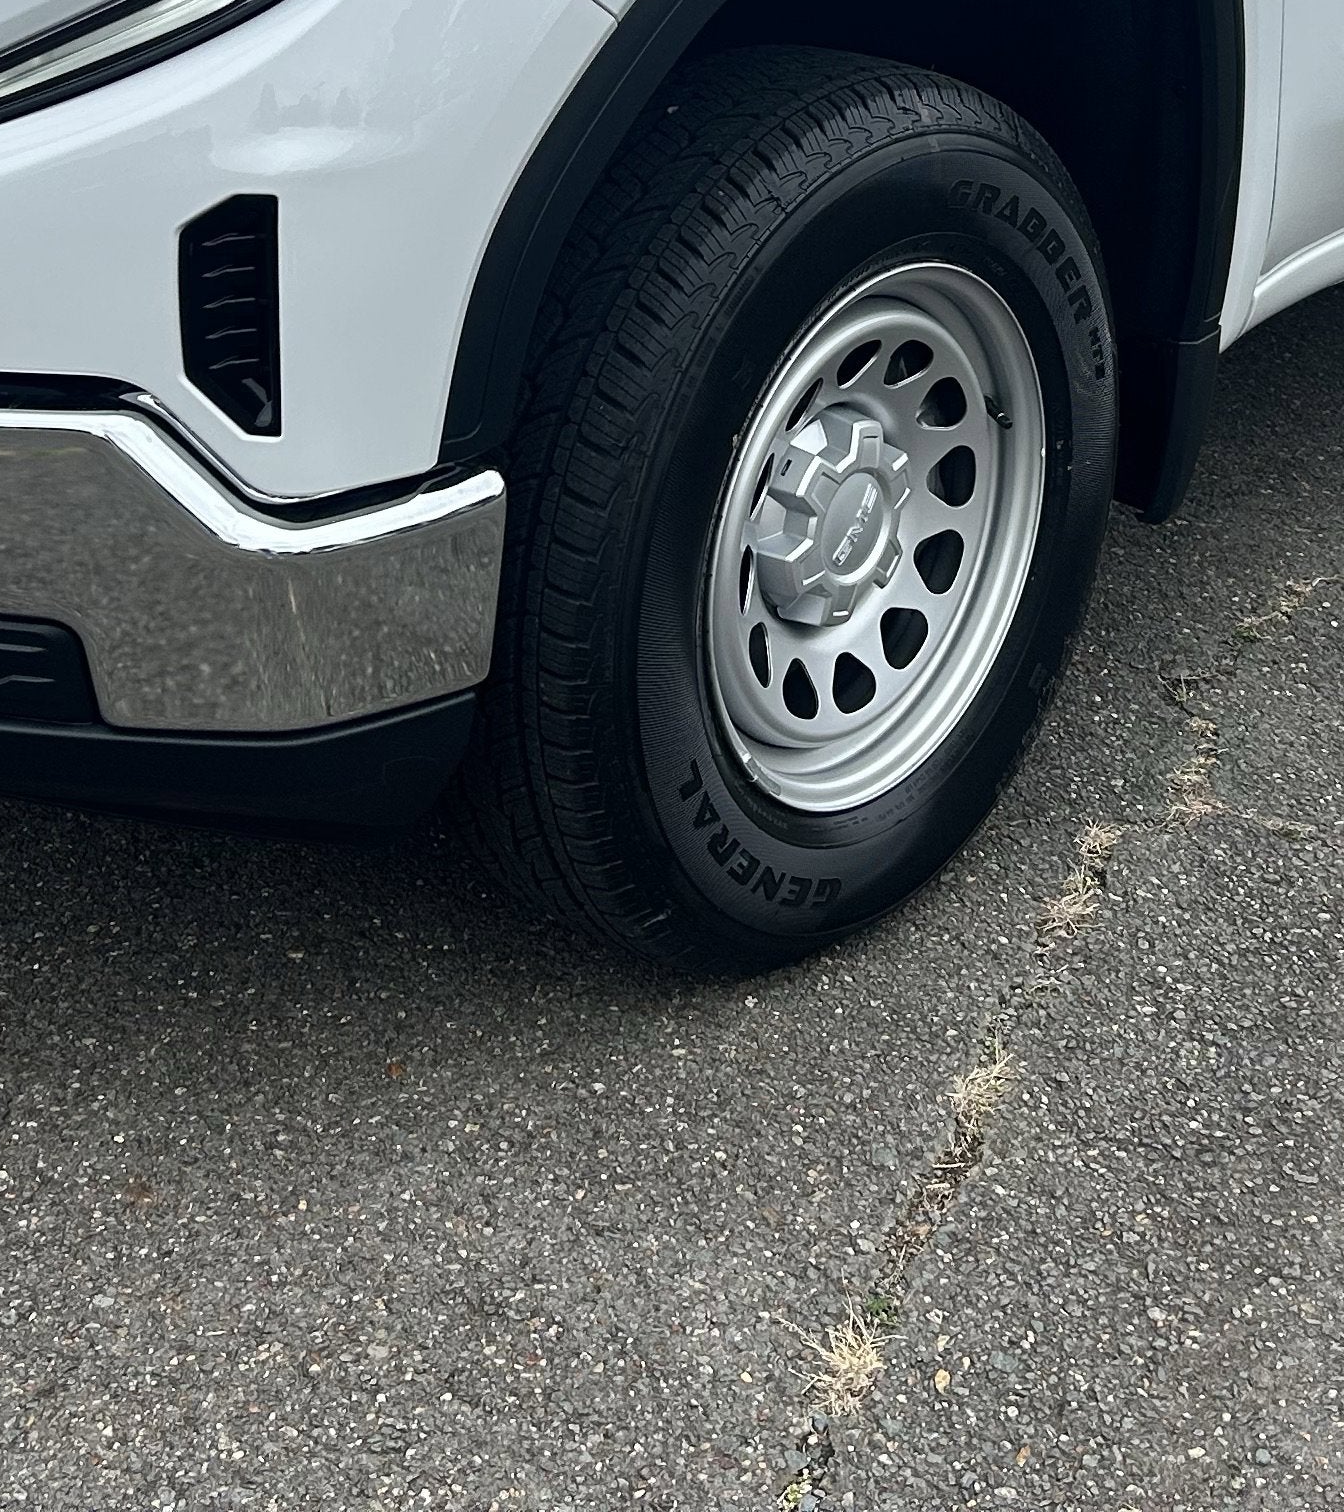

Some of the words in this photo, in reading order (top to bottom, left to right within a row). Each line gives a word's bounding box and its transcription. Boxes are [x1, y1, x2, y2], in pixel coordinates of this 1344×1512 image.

[947, 179, 1094, 324] GRABBER
[832, 483, 878, 566] GMC
[678, 758, 842, 907] GENERAL
